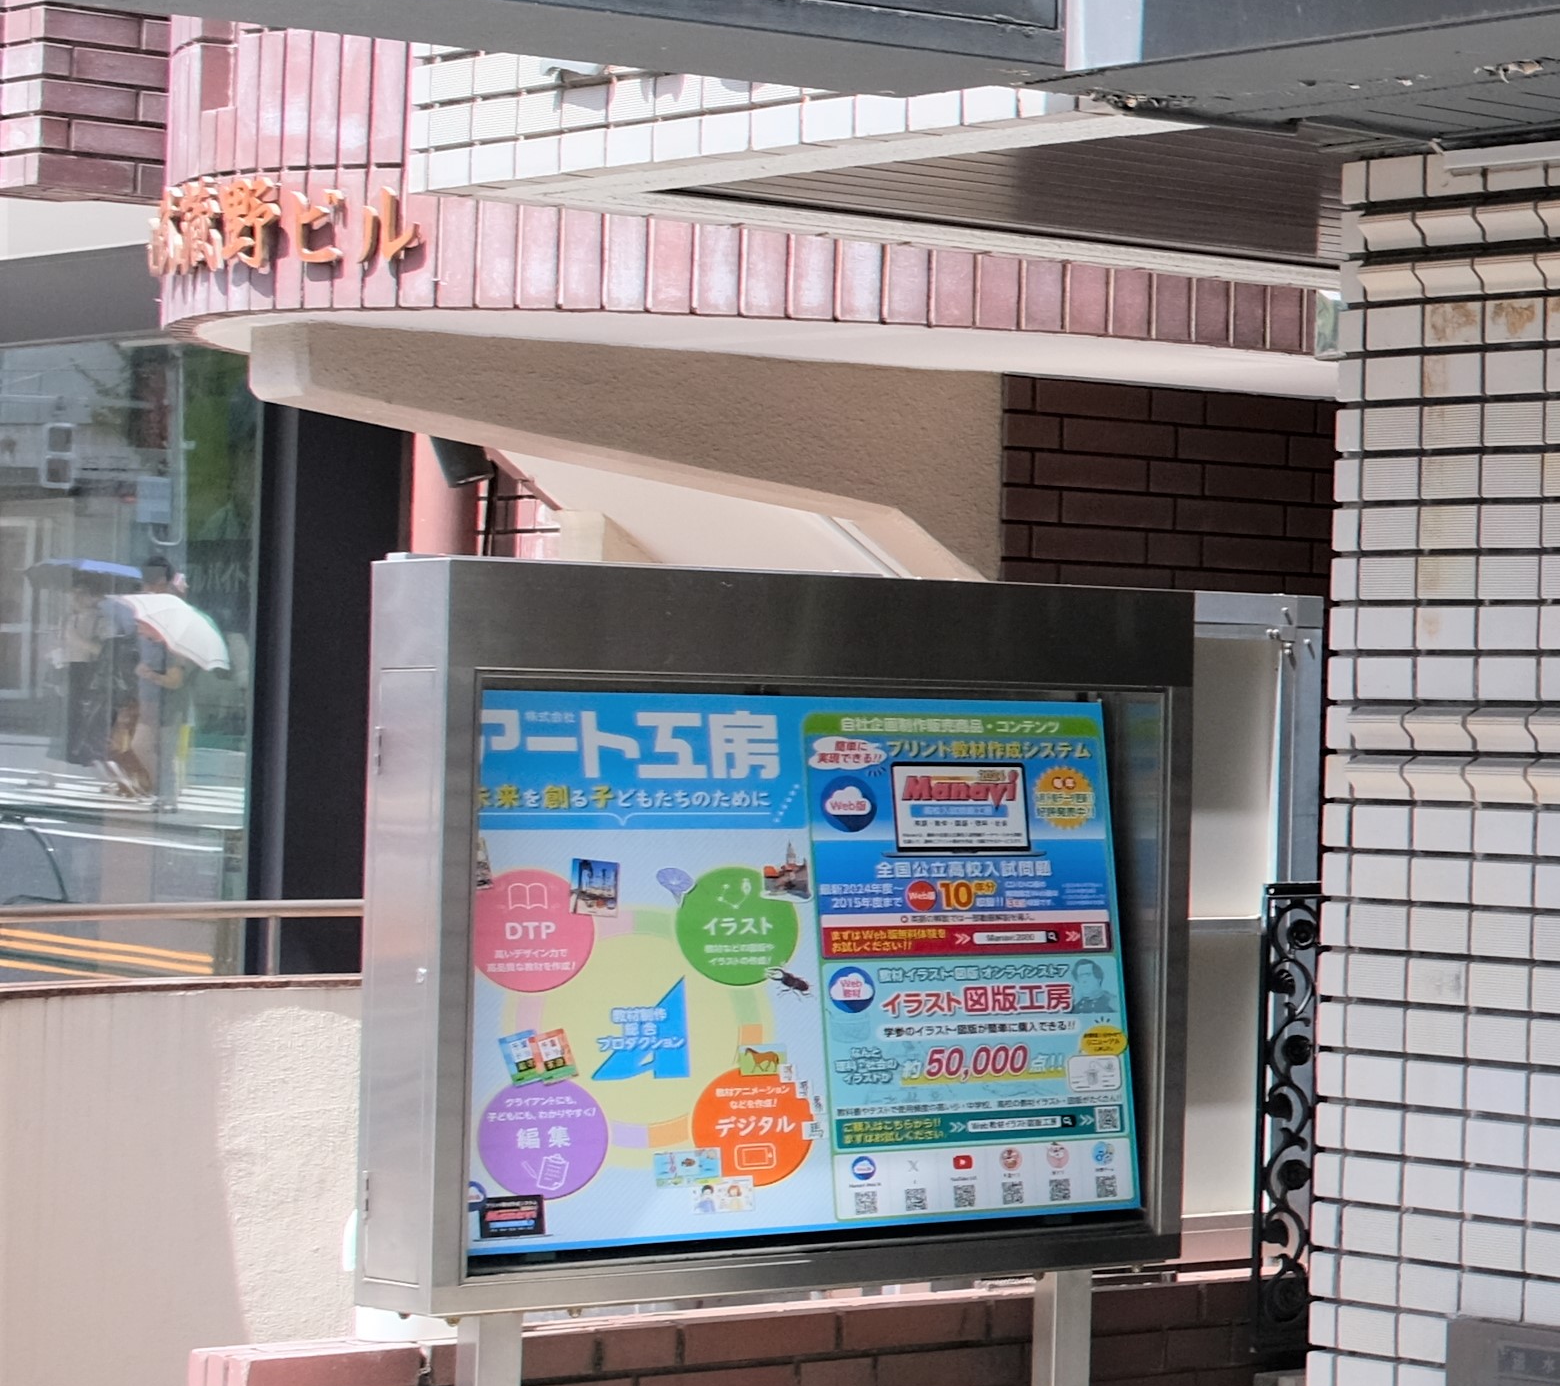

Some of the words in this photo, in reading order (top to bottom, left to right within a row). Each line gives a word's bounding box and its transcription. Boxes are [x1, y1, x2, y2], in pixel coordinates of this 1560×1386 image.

[886, 740, 1092, 760] プリント教材作成システム
[876, 861, 1052, 879] 全国公立高校入試問題
[505, 921, 557, 940] DTP
[703, 917, 774, 936] イラスト
[882, 983, 1073, 1015] イラスト図版工房
[597, 1034, 685, 1051] プロダクション
[715, 1115, 796, 1138] デジタル
[516, 1126, 572, 1149] 編集
